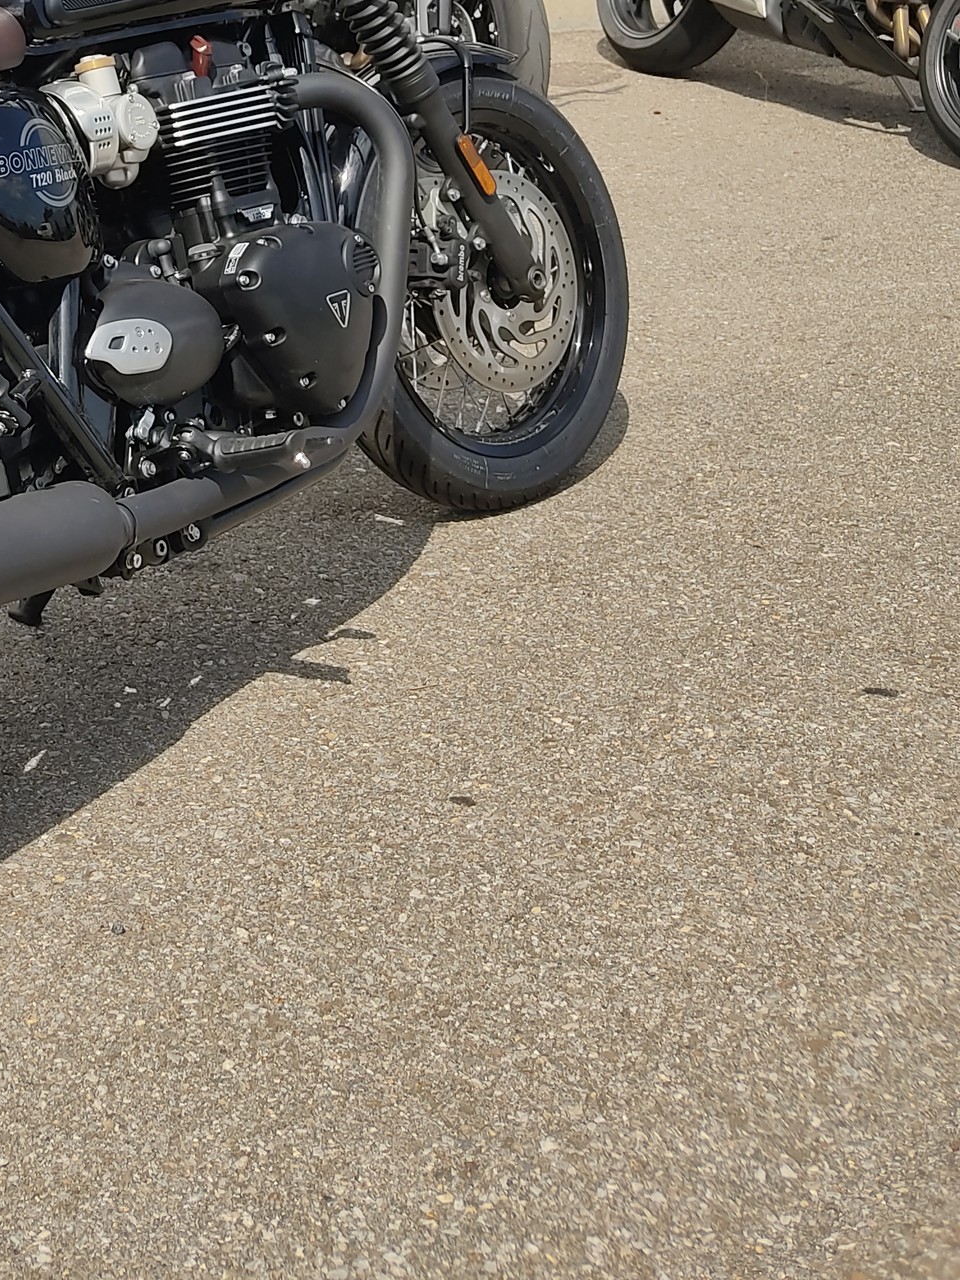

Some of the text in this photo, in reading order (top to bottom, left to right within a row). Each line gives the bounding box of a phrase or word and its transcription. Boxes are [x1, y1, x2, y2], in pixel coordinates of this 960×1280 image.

[30, 168, 77, 188] T120 Black
[457, 245, 465, 281] brembo
